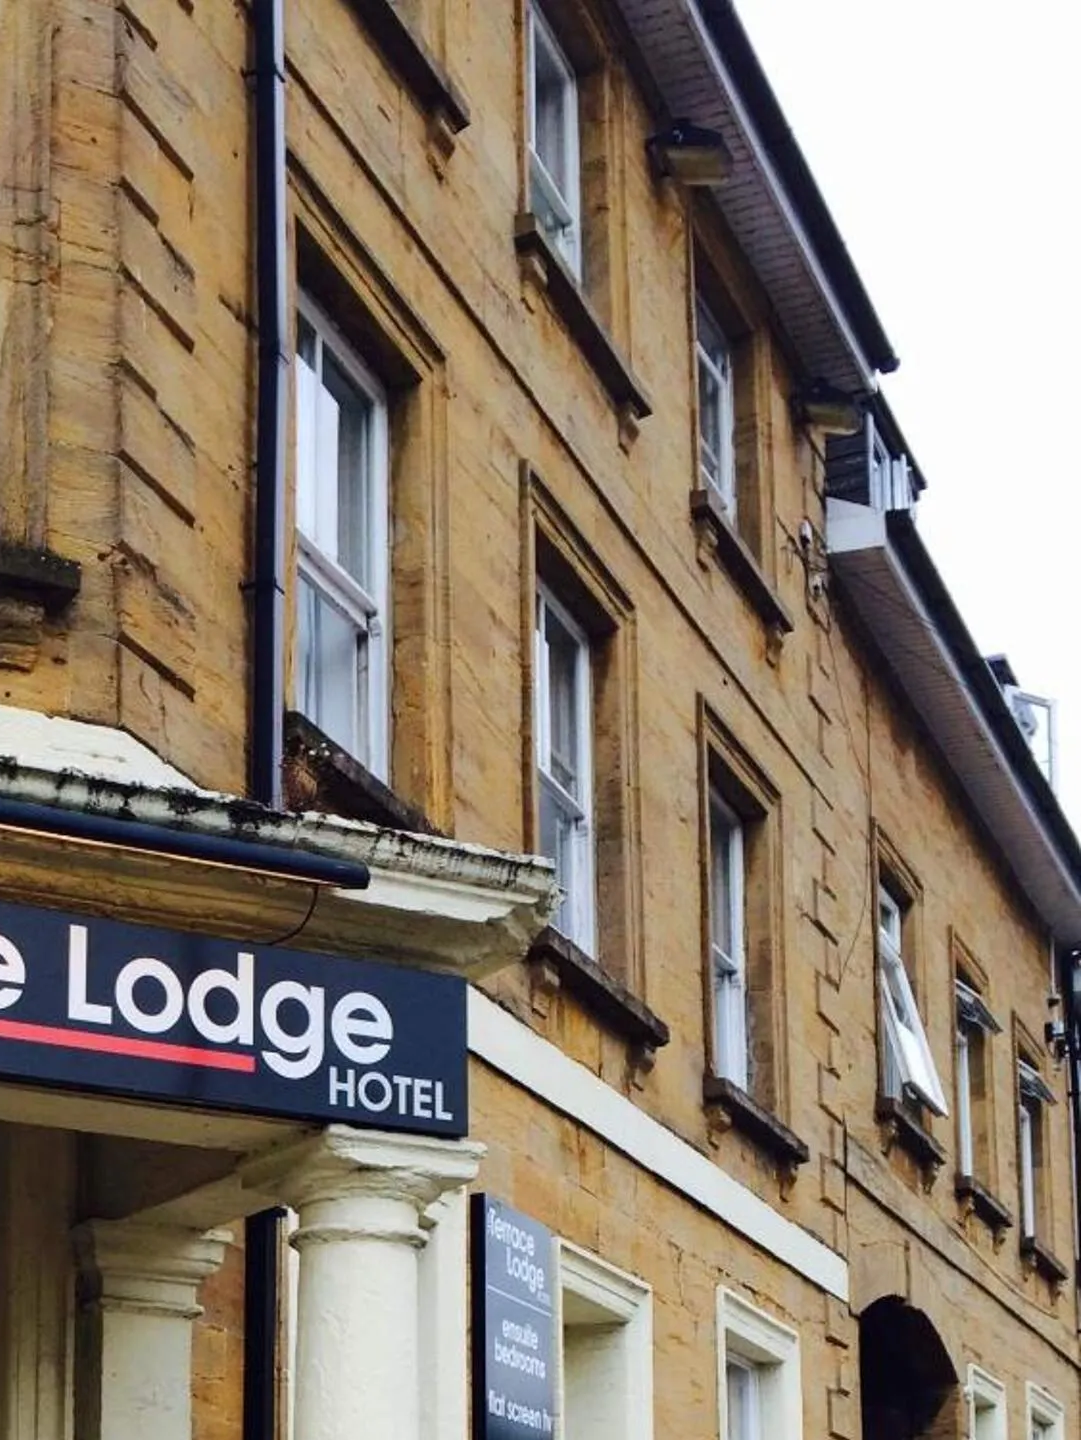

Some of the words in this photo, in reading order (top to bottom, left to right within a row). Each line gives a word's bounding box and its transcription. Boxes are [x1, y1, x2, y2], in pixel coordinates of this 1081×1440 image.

[68, 924, 393, 1079] Lodge
[328, 1064, 452, 1121] HOTEL
[494, 1336, 546, 1379] bedrooms
[507, 1399, 541, 1429] screen
